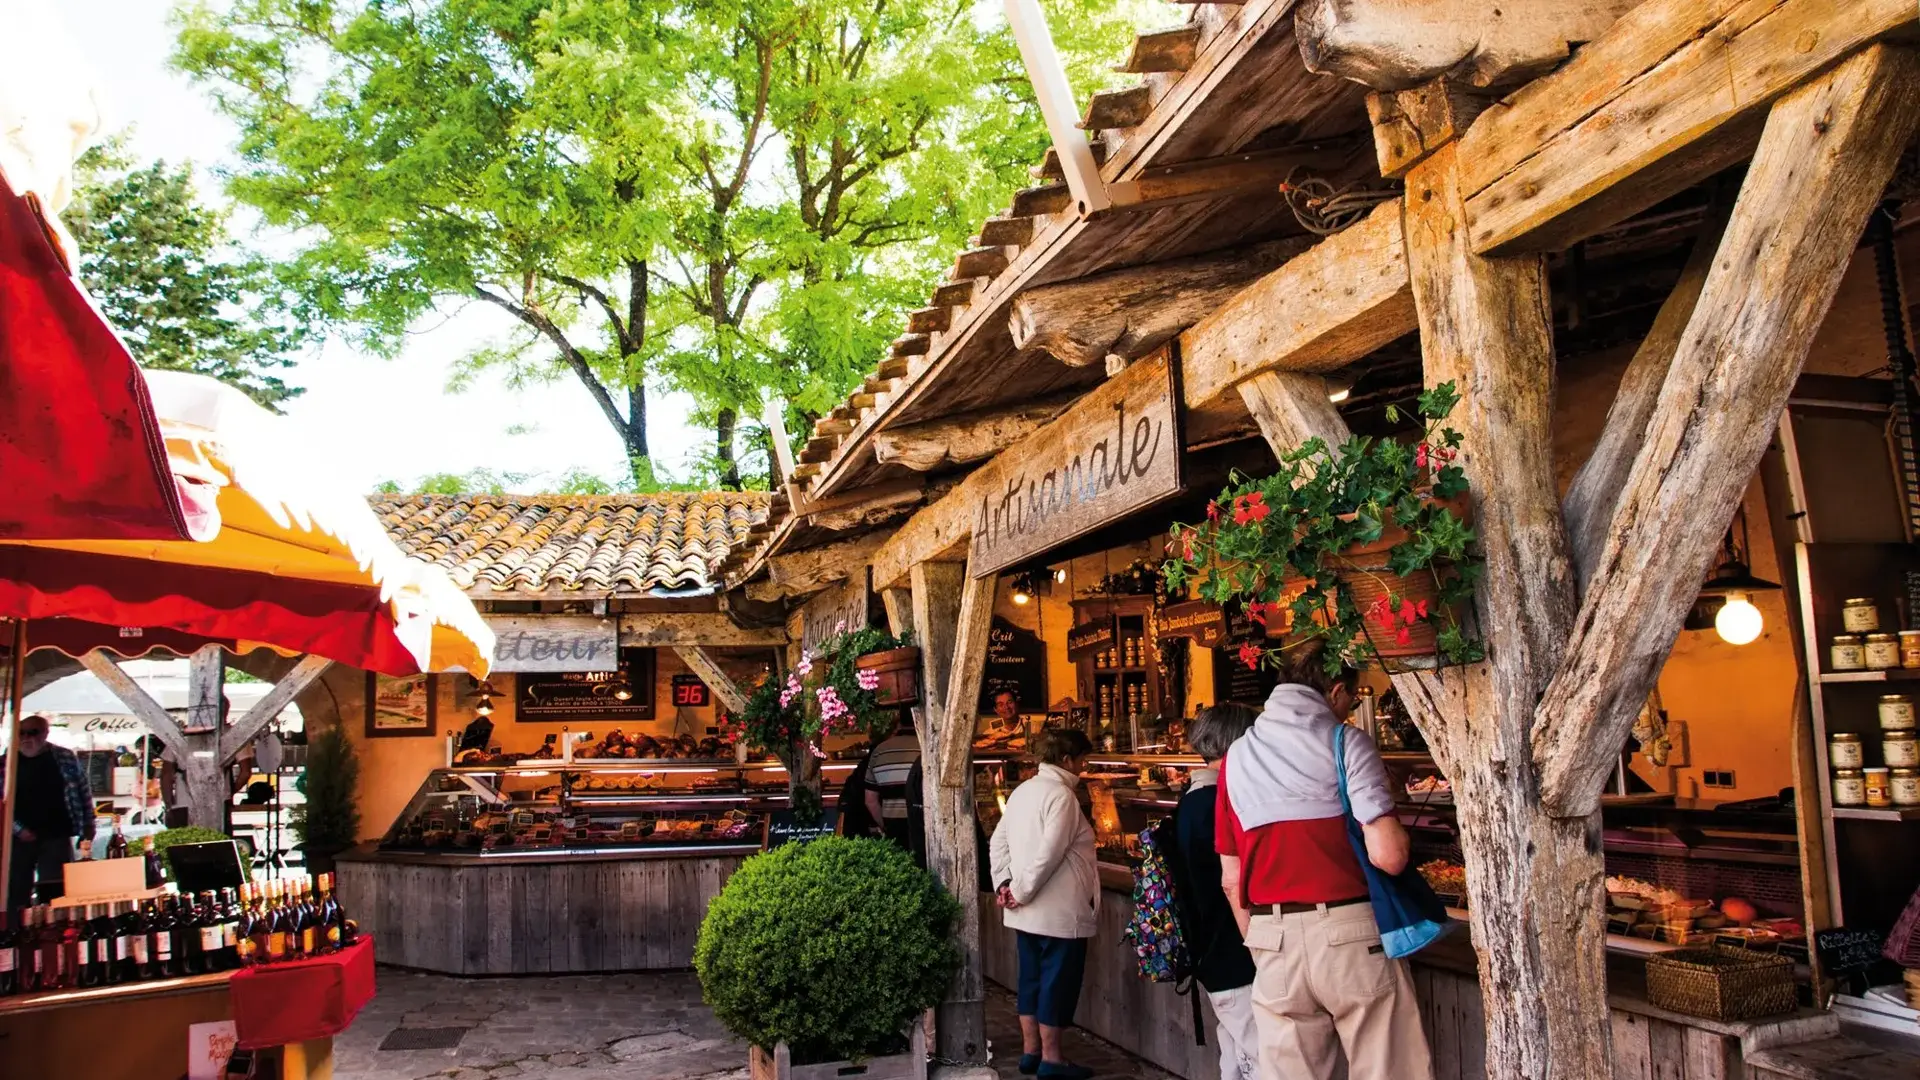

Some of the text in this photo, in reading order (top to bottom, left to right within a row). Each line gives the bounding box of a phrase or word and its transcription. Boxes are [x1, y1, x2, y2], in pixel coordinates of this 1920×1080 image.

[975, 399, 1162, 556] Artisanale
[989, 653, 1025, 664] Traiteur
[678, 685, 702, 704] 36
[85, 717, 138, 732] Coffee
